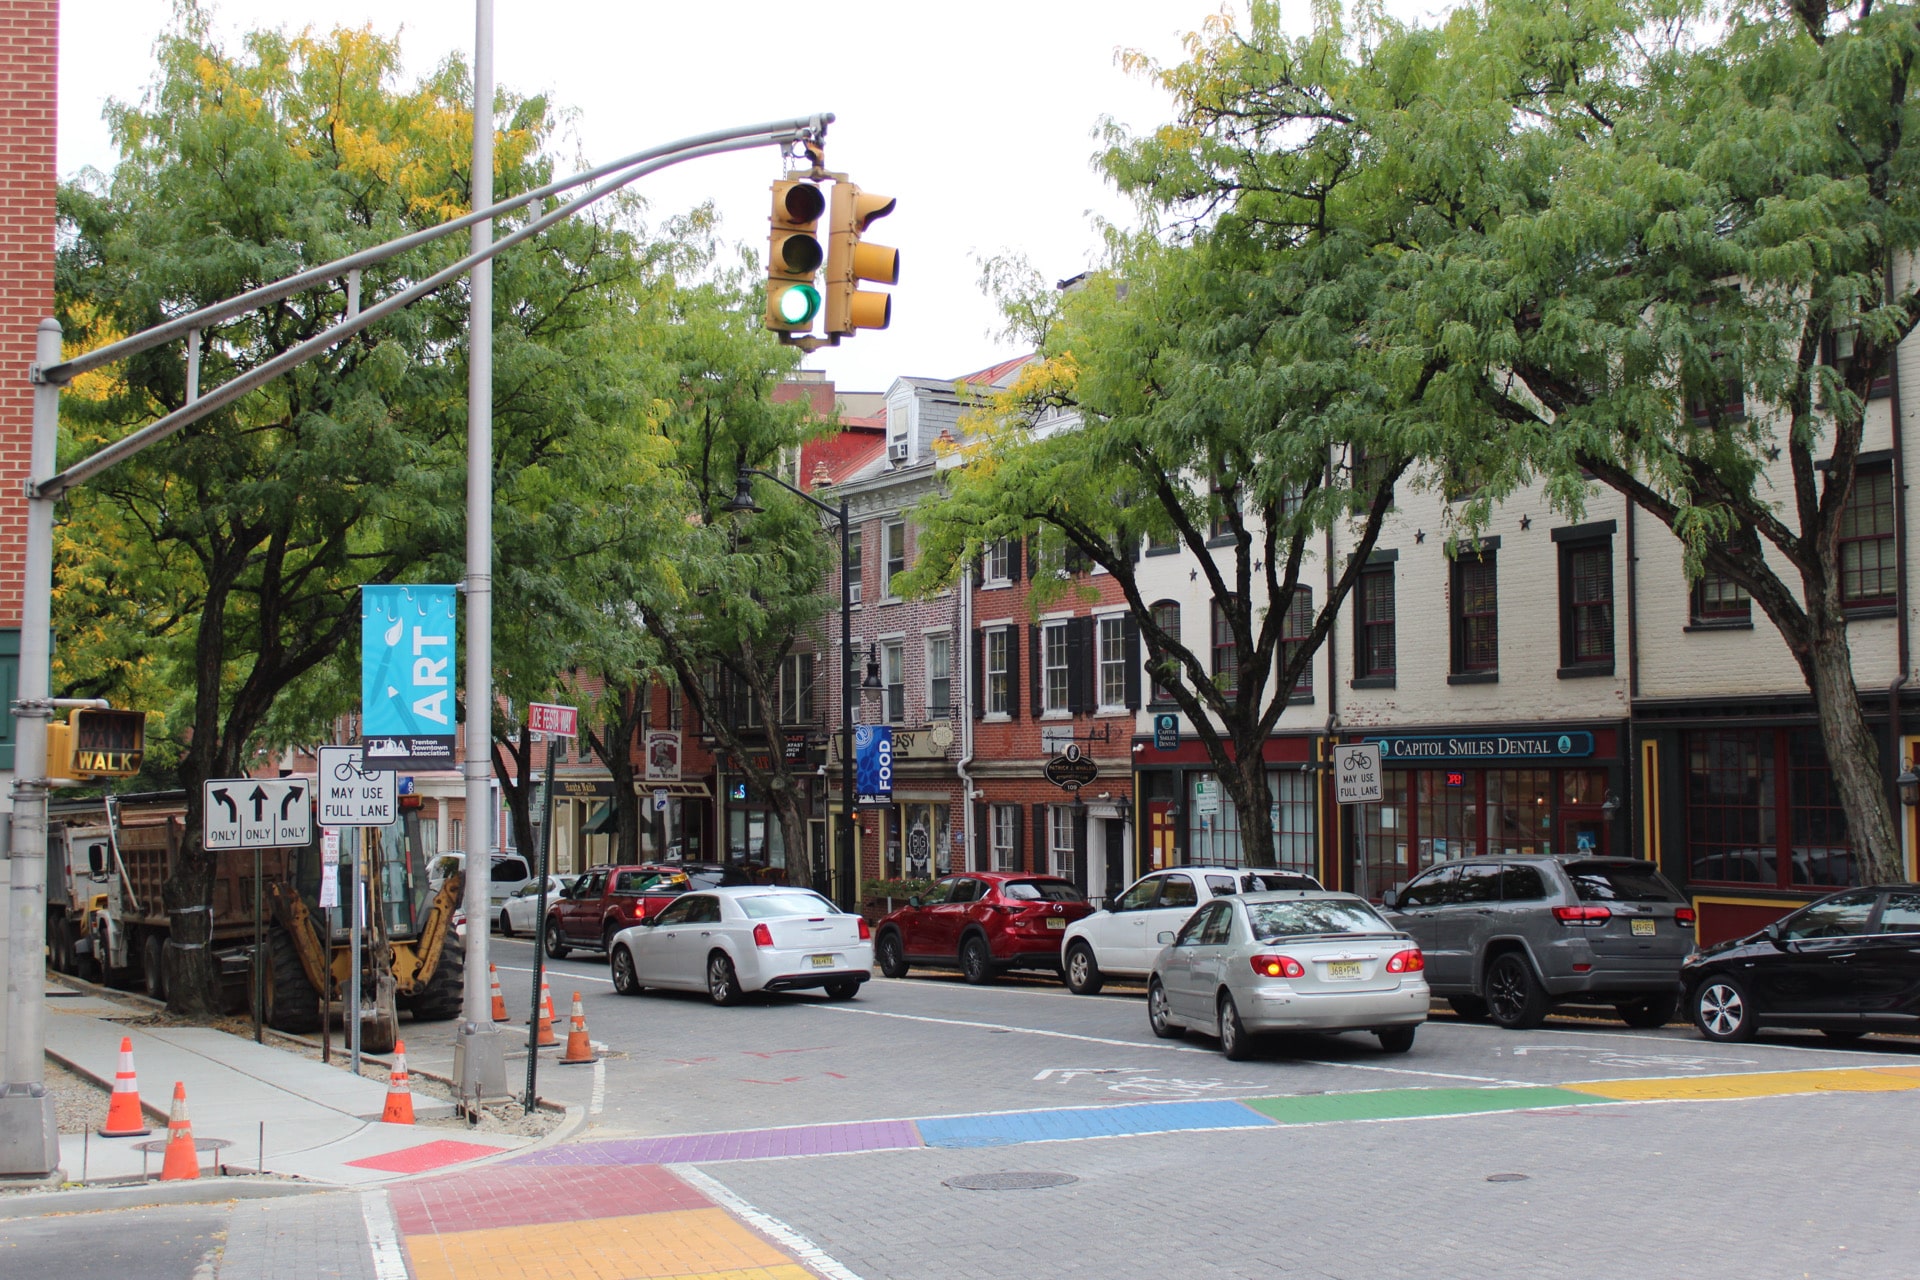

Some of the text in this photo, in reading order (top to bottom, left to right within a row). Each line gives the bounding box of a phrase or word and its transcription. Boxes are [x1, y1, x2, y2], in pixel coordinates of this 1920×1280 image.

[413, 626, 448, 725] ART
[532, 707, 573, 732] JOE FESTA WAY
[368, 738, 410, 756] TDA
[1395, 738, 1551, 756] CAPITOL SMILES DENTAL
[79, 752, 132, 771] WALK
[879, 740, 891, 790] FOOD
[1343, 773, 1374, 783] MAY USE
[331, 787, 383, 799] MAY USE
[1340, 786, 1379, 797] FULL LANE
[326, 805, 389, 817] FULL LANE
[211, 830, 237, 841] ONLY
[246, 828, 271, 839] ONLY
[281, 827, 306, 838] ONLY
[913, 834, 926, 848] BIG
